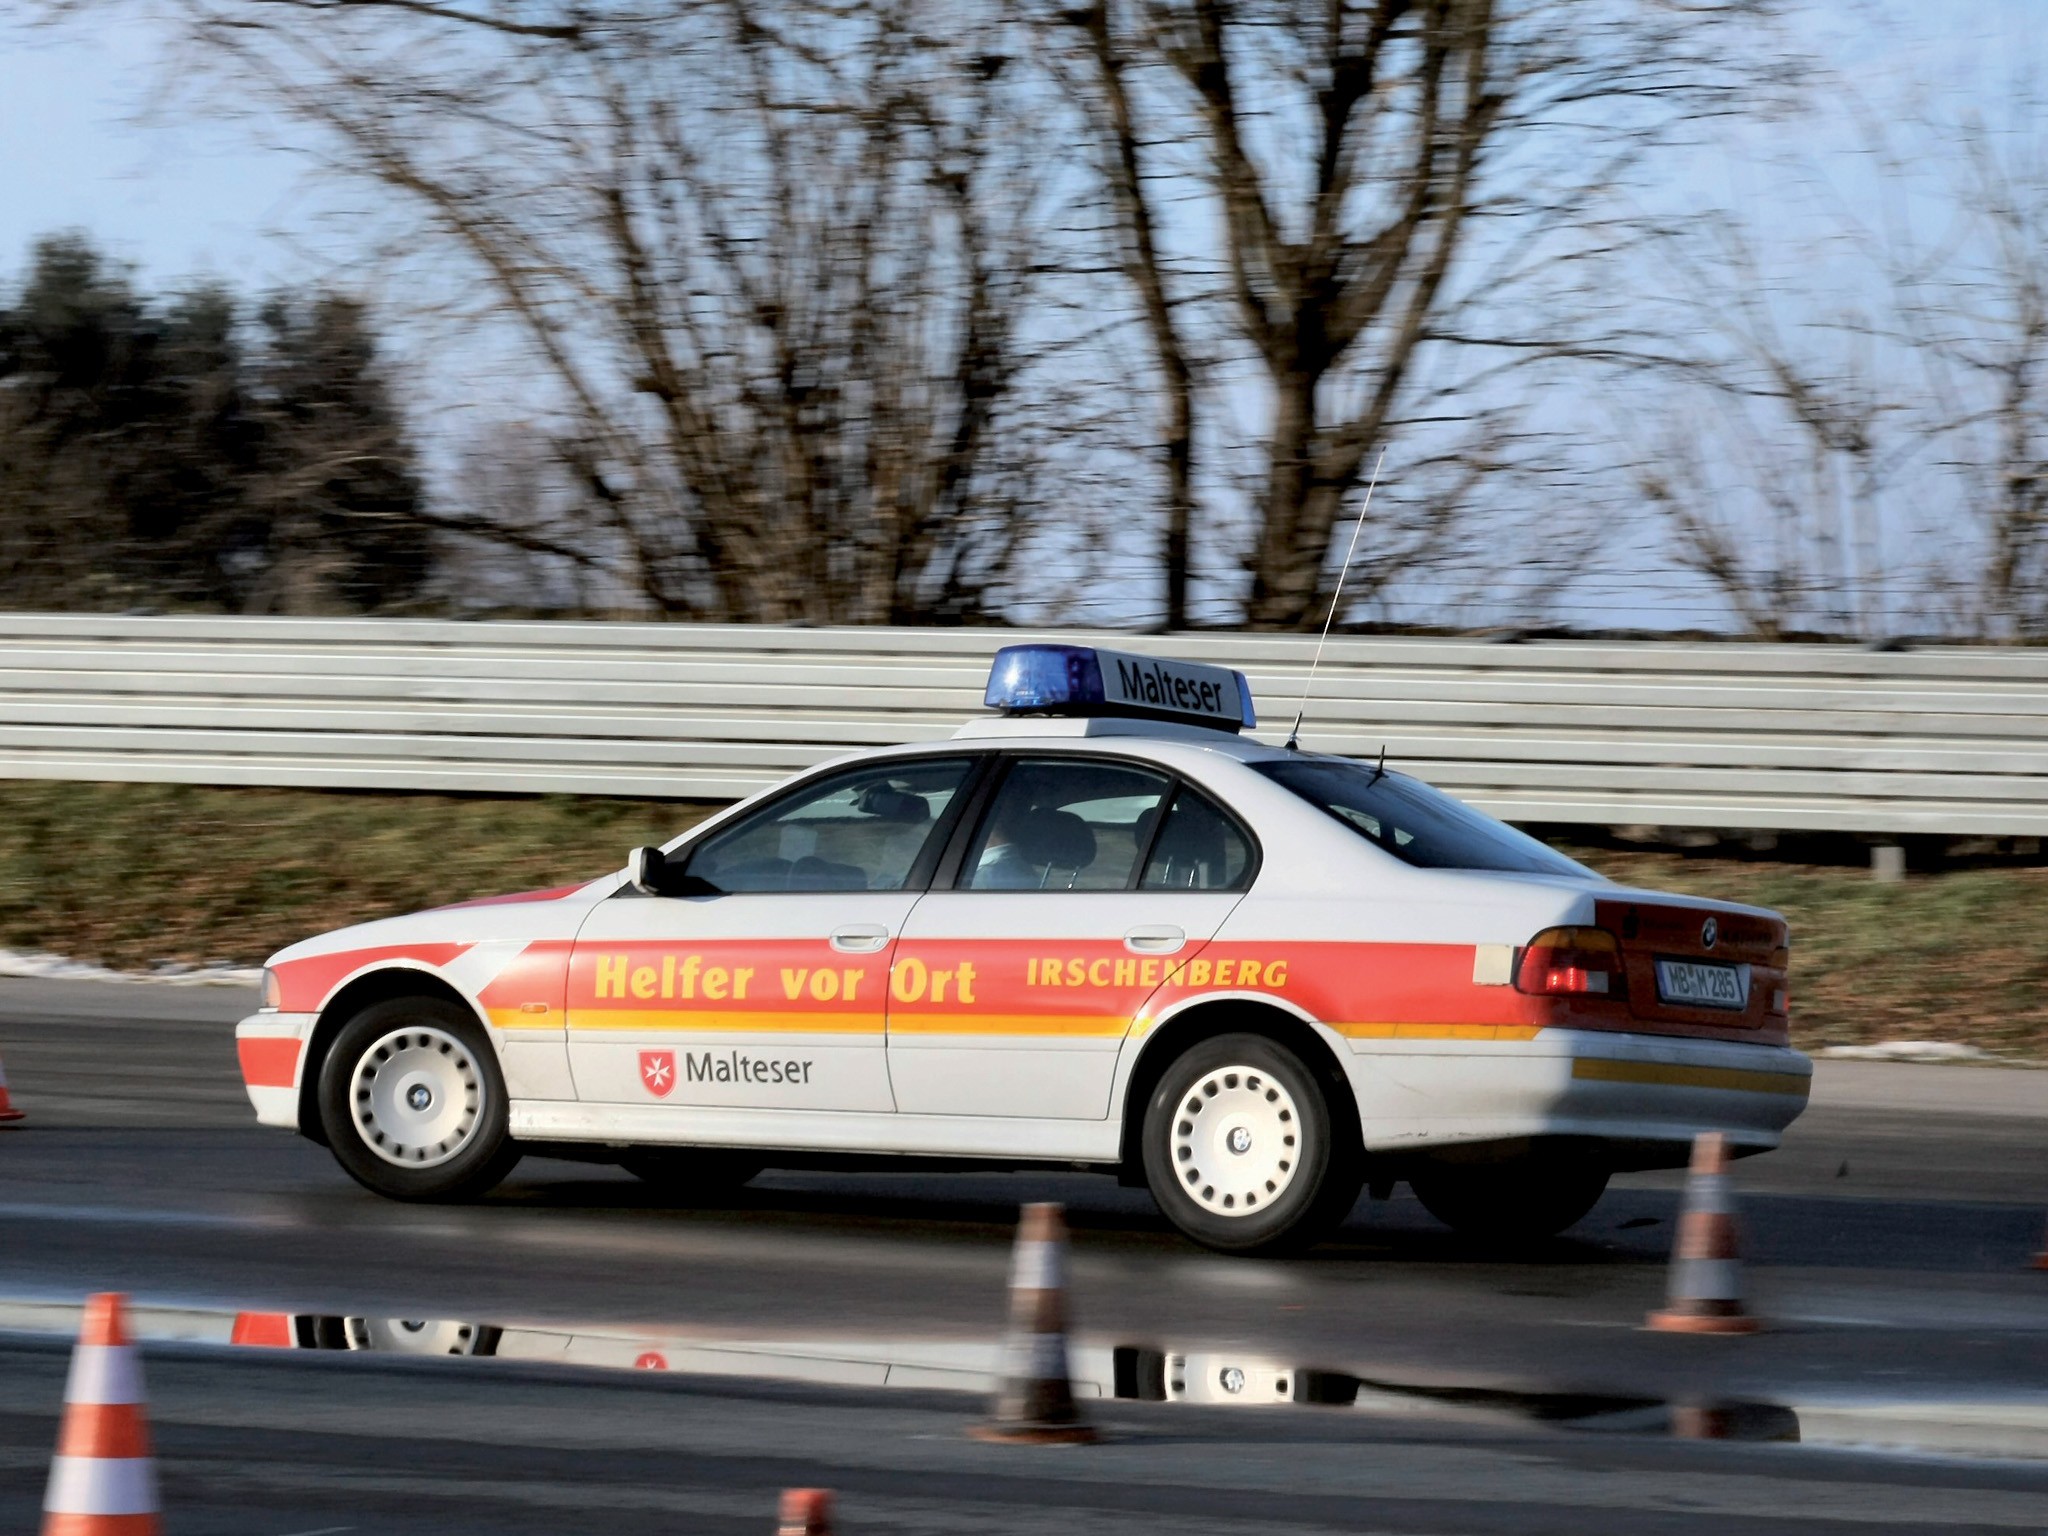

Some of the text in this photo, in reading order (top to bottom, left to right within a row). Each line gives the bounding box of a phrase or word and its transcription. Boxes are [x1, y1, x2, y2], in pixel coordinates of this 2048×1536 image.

[1117, 659, 1221, 712] Malteser
[595, 954, 977, 1004] Helfer vor Ort
[1026, 958, 1288, 987] IRSCHENBERG
[1668, 966, 1690, 994] MB
[1708, 970, 1735, 999] 285
[686, 1050, 813, 1084] Malteser
